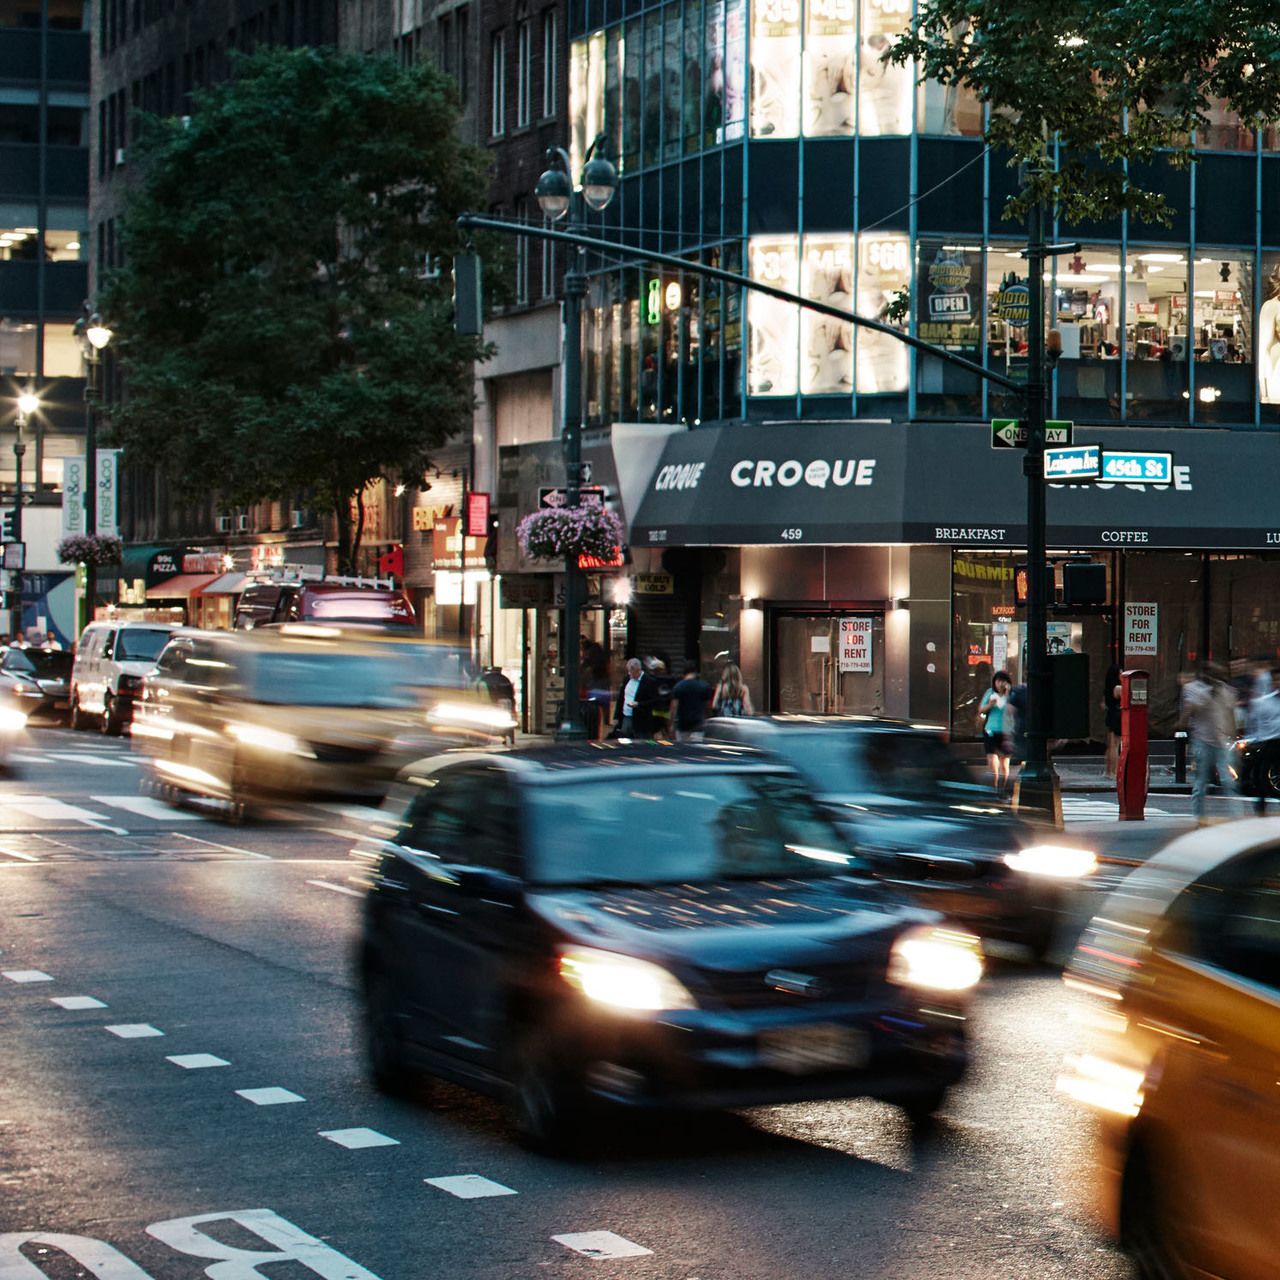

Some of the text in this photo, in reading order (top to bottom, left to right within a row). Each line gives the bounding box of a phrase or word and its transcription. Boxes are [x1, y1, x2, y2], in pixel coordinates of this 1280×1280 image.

[992, 291, 1030, 304] MIDTO
[935, 297, 964, 312] OPEN
[999, 307, 1030, 320] COMI
[1045, 429, 1063, 441] AY
[1046, 451, 1099, 474] Lexington Ave
[1105, 459, 1163, 477] 45th St
[655, 462, 705, 491] CROQUE
[730, 459, 876, 489] CROQUE
[66, 463, 81, 532] fresh&co
[98, 458, 113, 529] fresh&co
[780, 529, 803, 540] 459
[935, 527, 1006, 541] BREAKFAST
[1101, 531, 1149, 543] COFFEE
[153, 564, 177, 572] PIZZA
[1126, 606, 1156, 616] STORE
[841, 621, 870, 631] STORE
[1132, 619, 1150, 629] FOR
[1129, 633, 1152, 642] RENT
[844, 649, 867, 658] RENT
